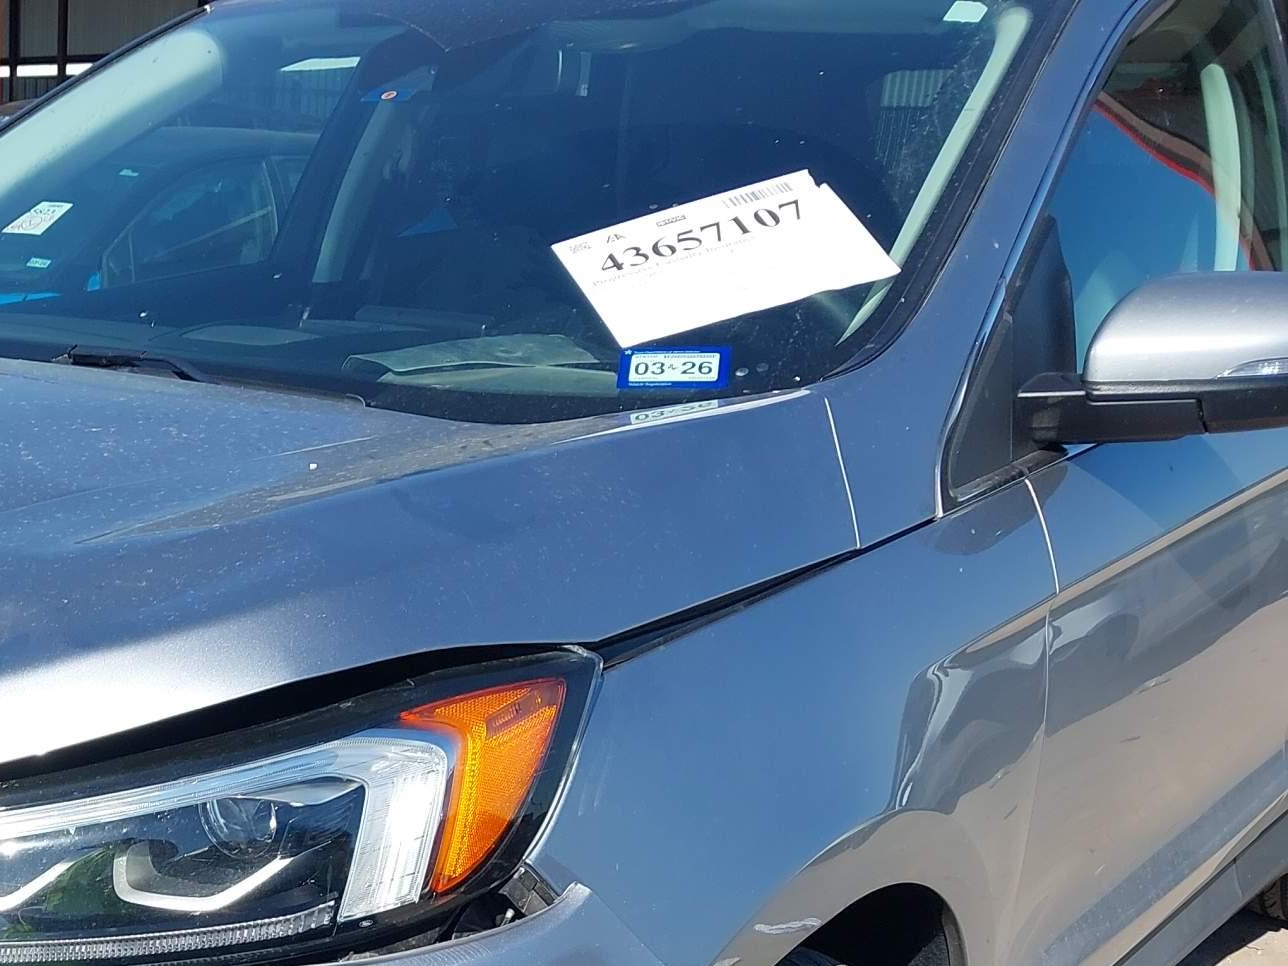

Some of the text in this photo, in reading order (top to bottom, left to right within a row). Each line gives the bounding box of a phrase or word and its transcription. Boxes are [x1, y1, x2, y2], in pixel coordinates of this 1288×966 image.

[601, 199, 801, 271] 43657107
[634, 360, 714, 376] 03 26
